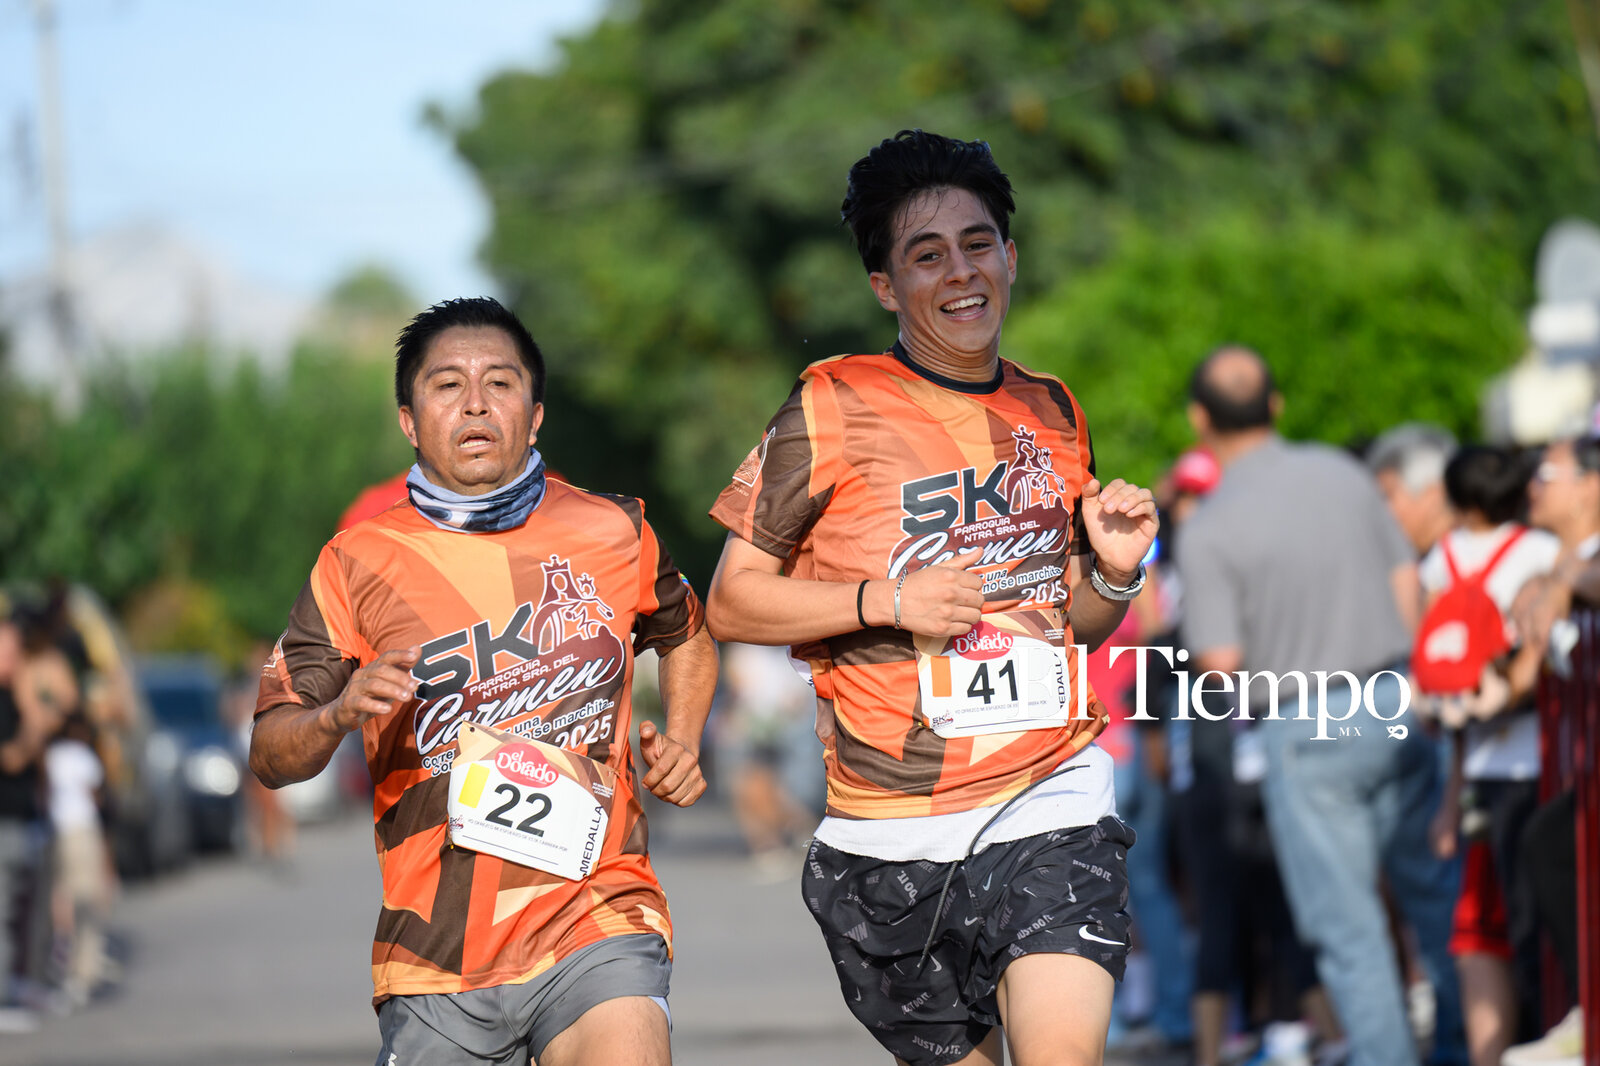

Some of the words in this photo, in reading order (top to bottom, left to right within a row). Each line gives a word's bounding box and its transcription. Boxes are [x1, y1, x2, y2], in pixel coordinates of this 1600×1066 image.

[901, 461, 1012, 537] 5K
[954, 517, 1010, 537] PARROQUIA
[964, 530, 995, 544] NTRA.
[996, 524, 1019, 536] SRA.
[1020, 520, 1040, 531] DEL
[983, 581, 999, 594] no
[1001, 576, 1014, 588] se
[986, 569, 1007, 581] una
[955, 632, 1013, 654] Dorado
[967, 629, 978, 641] el
[410, 602, 539, 701] 5K
[469, 659, 541, 696] PARROQUIA
[482, 678, 520, 700] NTRA.
[521, 664, 552, 682] SRA.
[553, 653, 580, 670] DEL
[967, 659, 1018, 704] 41
[415, 656, 615, 756] Carmen
[514, 716, 540, 734] una
[534, 724, 550, 737] se
[555, 714, 612, 750] 2025
[512, 750, 524, 761] el
[497, 752, 557, 783] Dorado
[485, 783, 552, 838] 22
[580, 804, 604, 875] MEDALLA
[810, 861, 824, 879] JUST
[1090, 865, 1103, 876] DO
[904, 882, 918, 899] DO
[1017, 926, 1034, 940] JUST
[1032, 918, 1046, 930] DO
[912, 1035, 934, 1052] JUST
